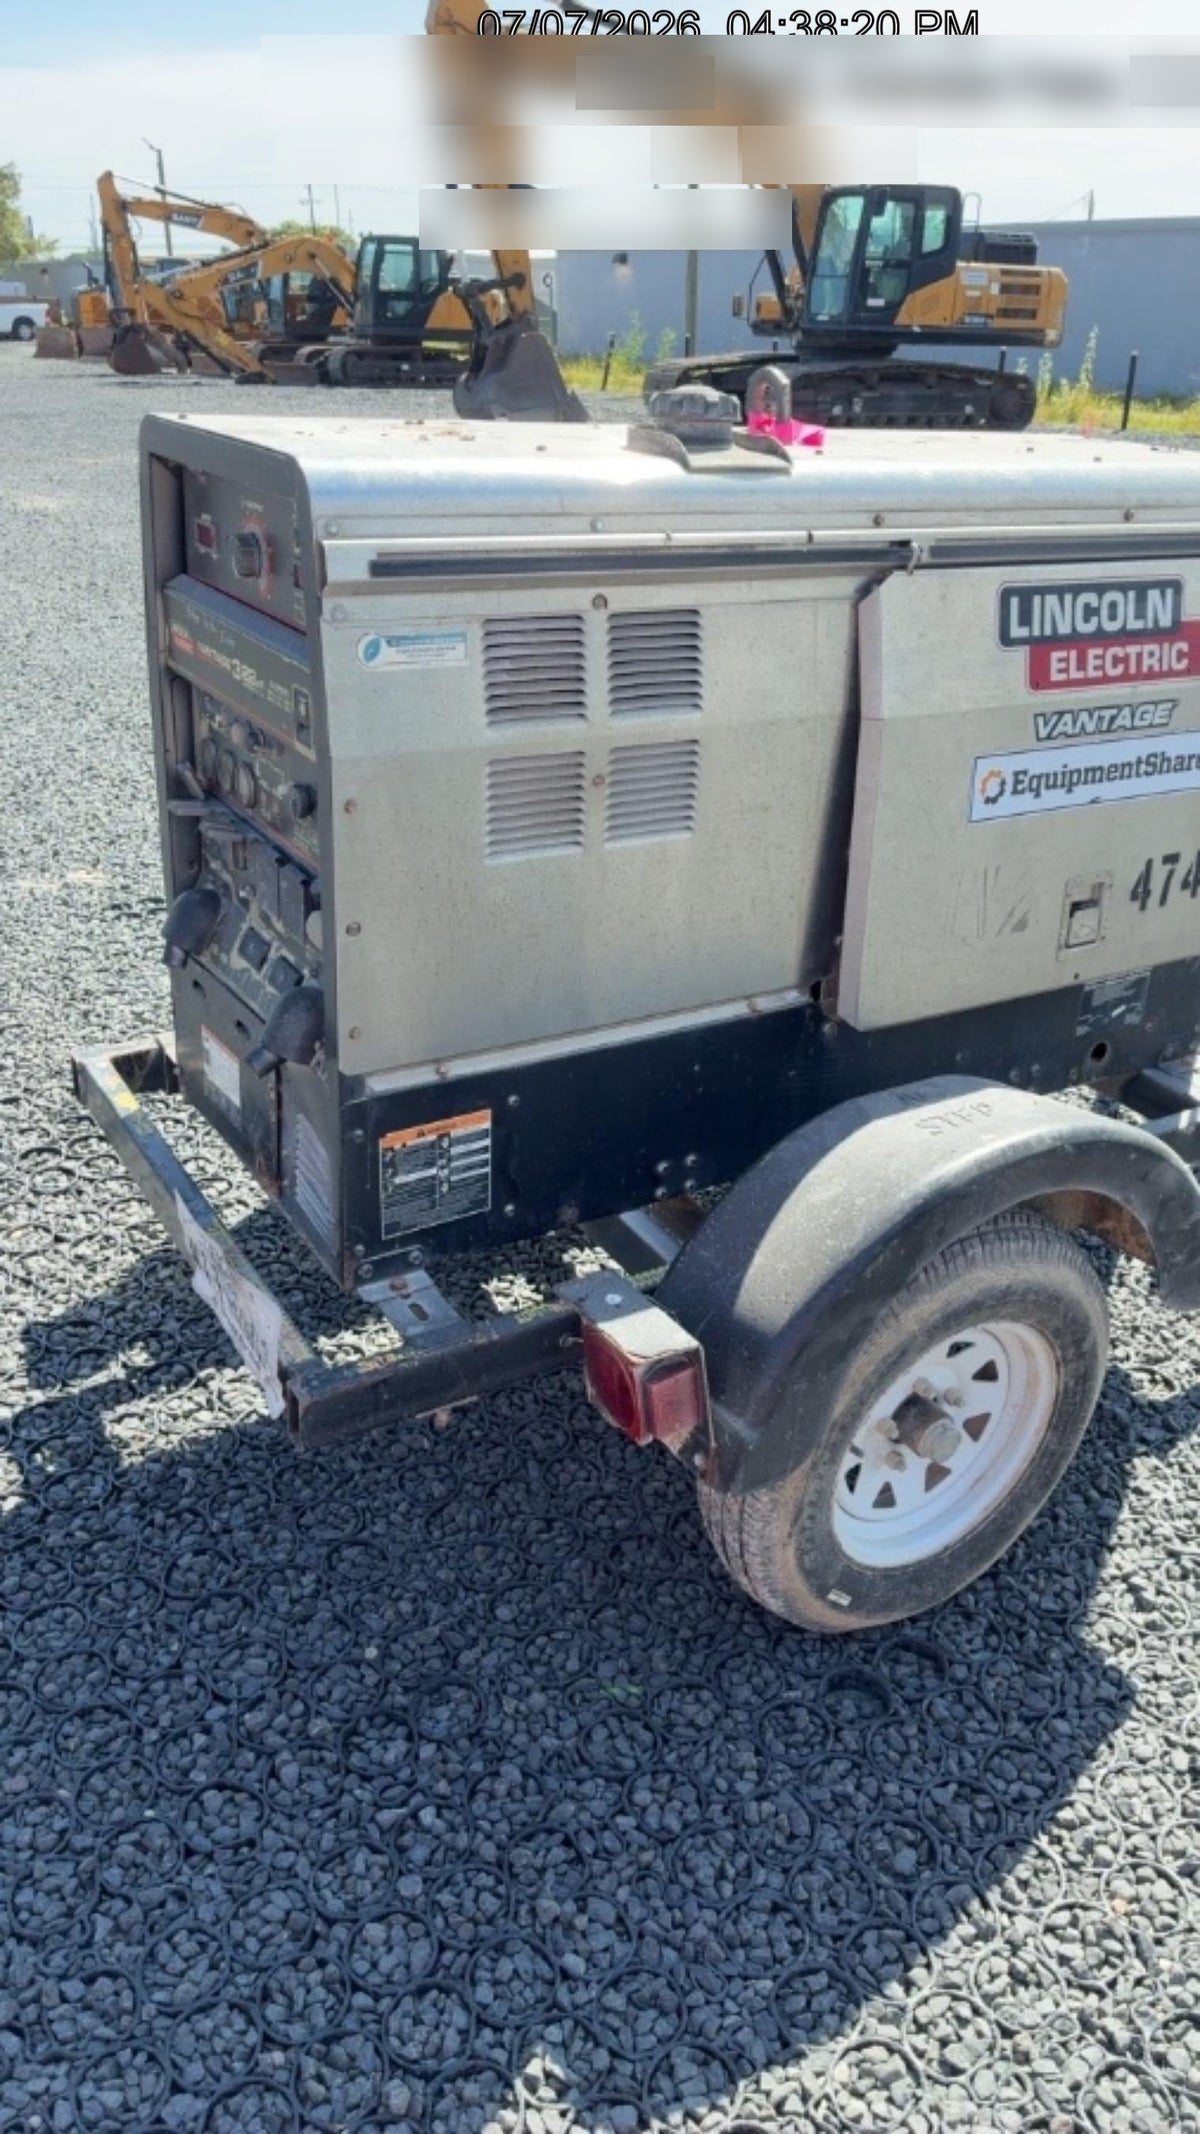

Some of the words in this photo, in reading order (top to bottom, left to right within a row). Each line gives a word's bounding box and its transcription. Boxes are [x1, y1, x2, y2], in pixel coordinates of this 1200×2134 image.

[1009, 588, 1174, 639] LINCOLN
[1050, 641, 1189, 683] ELECTRIC
[1035, 701, 1178, 741] VANTAGE
